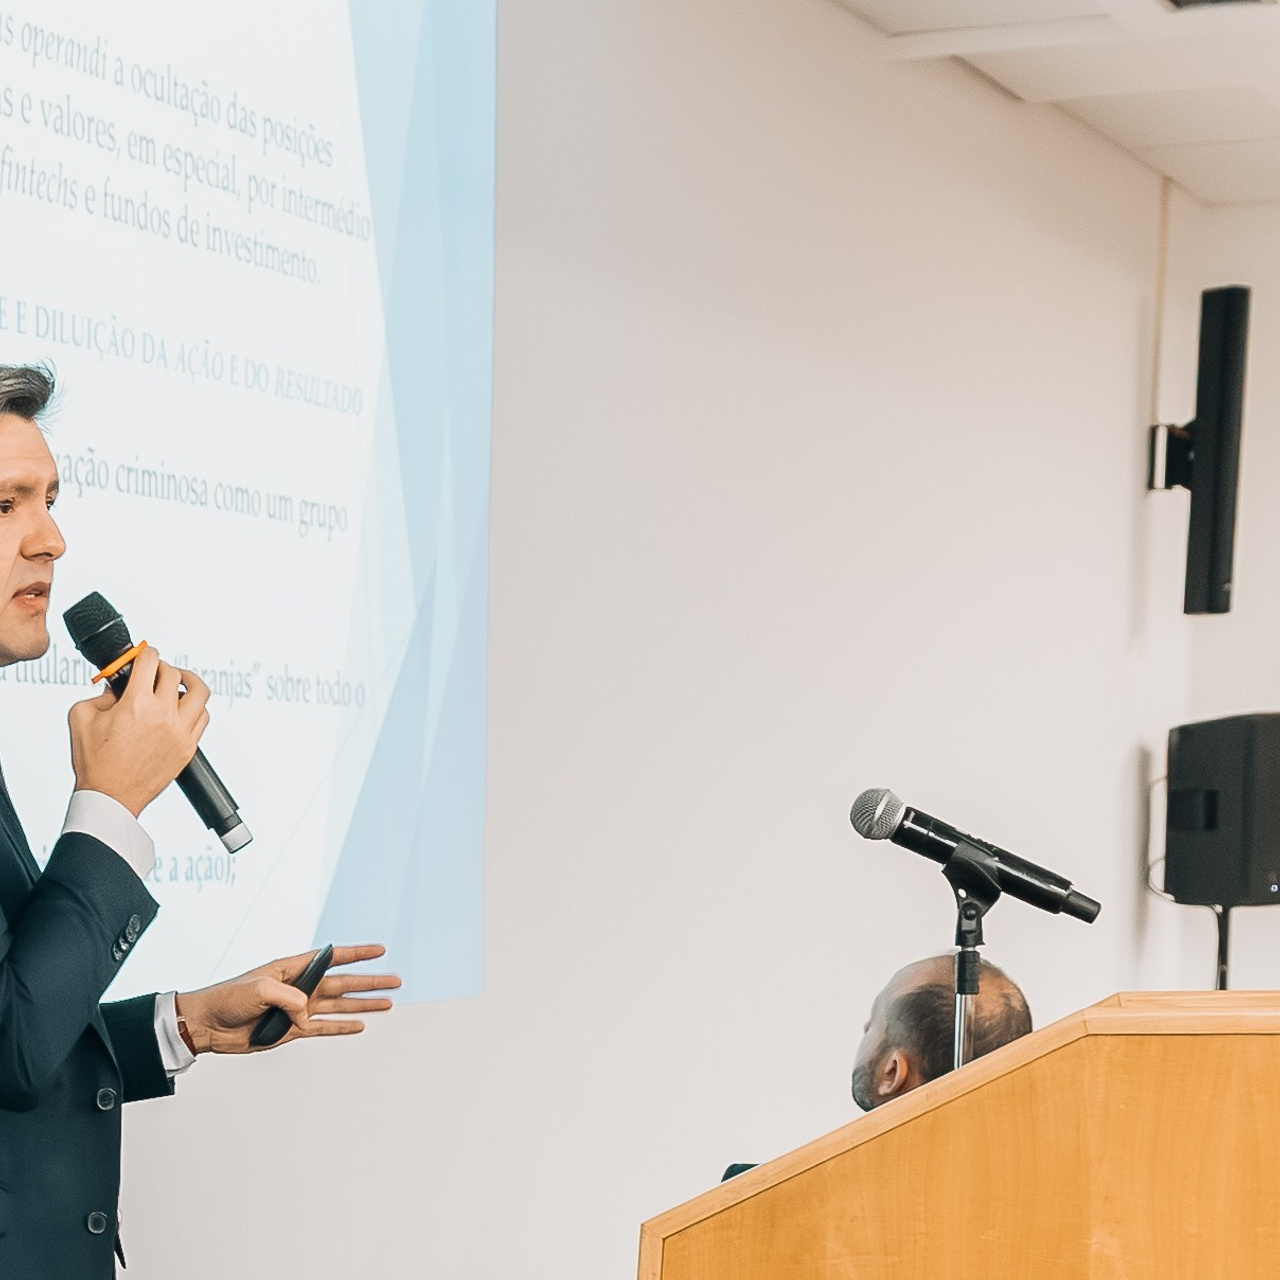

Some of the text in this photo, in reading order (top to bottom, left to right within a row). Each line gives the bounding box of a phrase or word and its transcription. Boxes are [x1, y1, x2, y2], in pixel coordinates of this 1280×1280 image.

[21, 22, 107, 80] operandi
[131, 62, 221, 127] ocultação
[227, 90, 257, 138] das
[263, 115, 333, 168] posições
[20, 93, 32, 124] e
[40, 94, 121, 161] valores,
[128, 130, 157, 168] em
[163, 143, 241, 202] especial,
[248, 173, 277, 215] por
[282, 174, 371, 242] intermédio
[85, 185, 96, 214] e
[103, 177, 171, 238] fundos
[177, 204, 200, 247] de
[206, 212, 321, 285] investimento.
[16, 300, 28, 335] E
[35, 304, 135, 362] DILUIÇÃO
[142, 331, 169, 369] DA
[174, 339, 224, 384] AÇÃO
[230, 354, 239, 386] E
[244, 358, 270, 394] DO
[275, 366, 364, 416] RESULTADO
[116, 455, 208, 507] criminosa
[214, 481, 261, 517] como
[267, 492, 294, 523] um
[299, 497, 348, 542] grupo
[267, 665, 312, 703] sobre
[317, 671, 352, 707] todo
[356, 682, 366, 709] o
[169, 856, 179, 882] a
[185, 845, 237, 893] ação);
